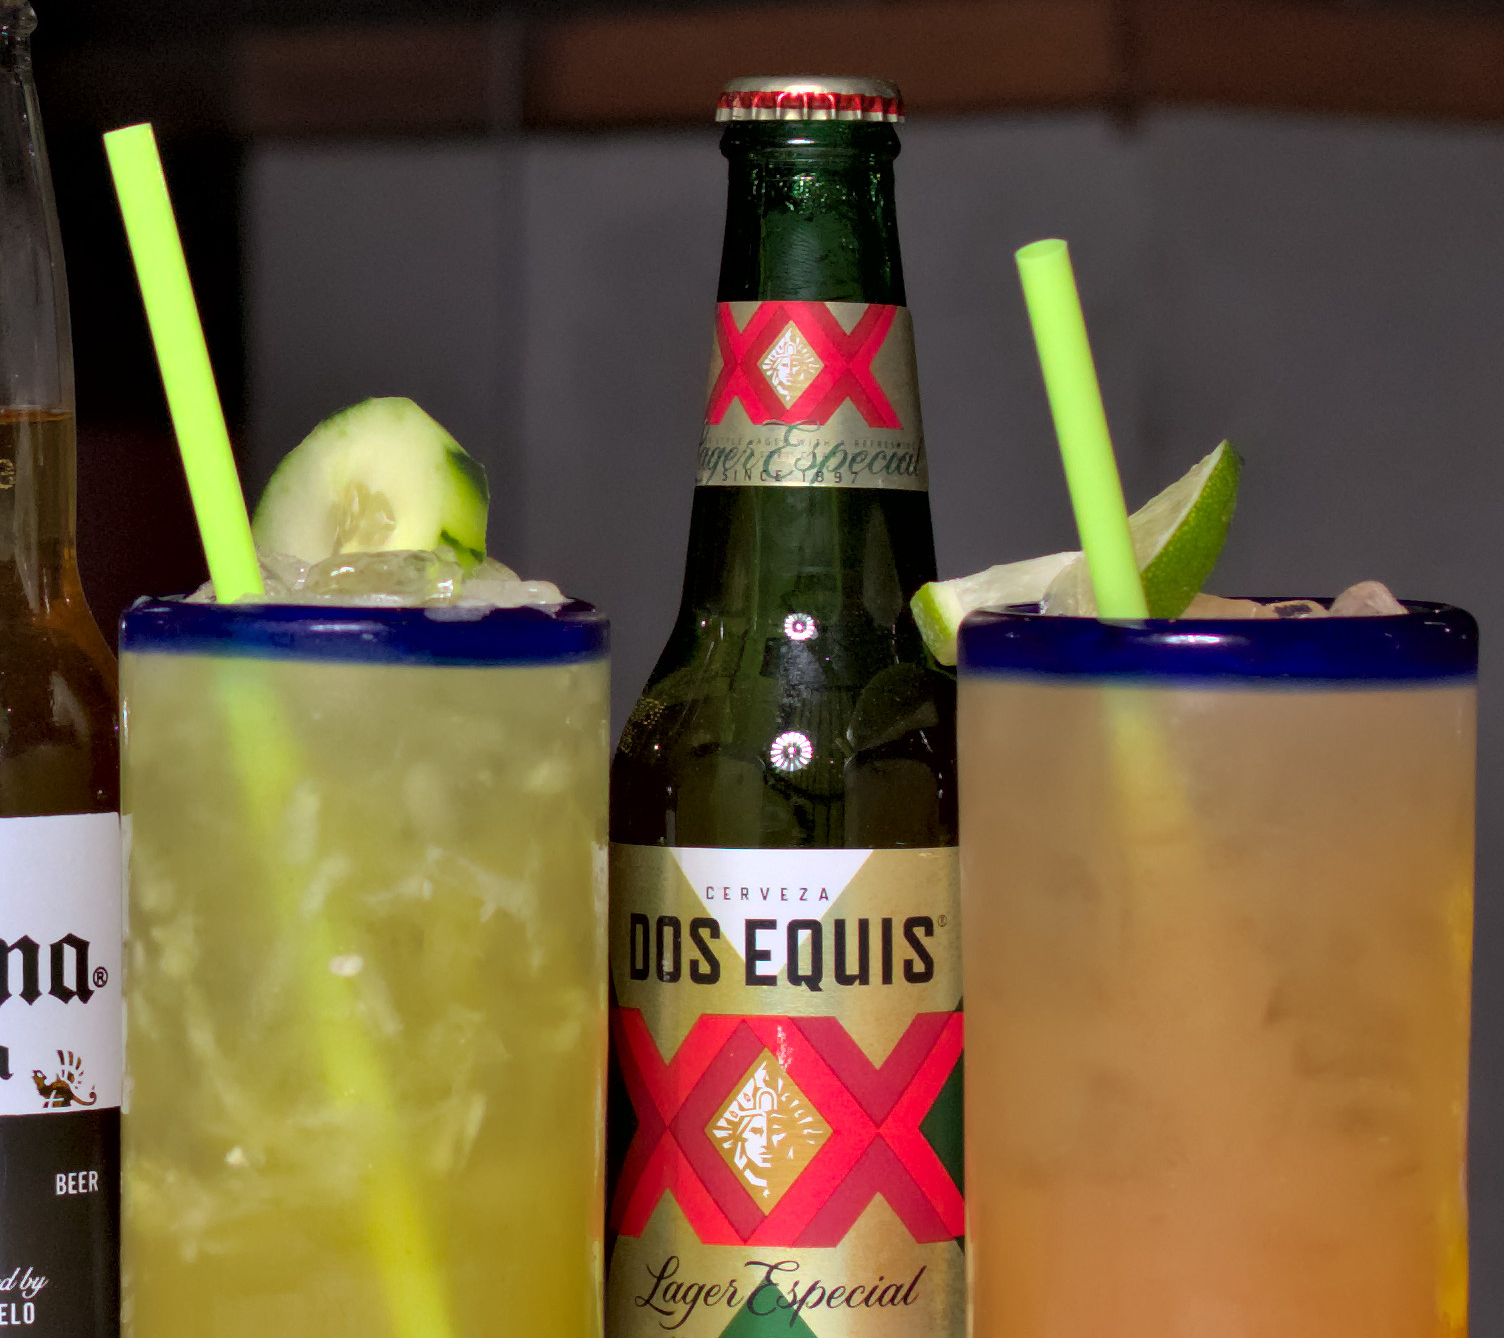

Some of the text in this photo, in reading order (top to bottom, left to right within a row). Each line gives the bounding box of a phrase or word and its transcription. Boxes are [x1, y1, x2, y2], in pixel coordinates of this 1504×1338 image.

[722, 470, 858, 484] SINCE 1897
[705, 885, 830, 902] CERVEZA
[629, 912, 935, 993] DOS EQUIS
[55, 1170, 99, 1196] BEER
[18, 1267, 49, 1299] by
[634, 1255, 928, 1331] Lager Especial
